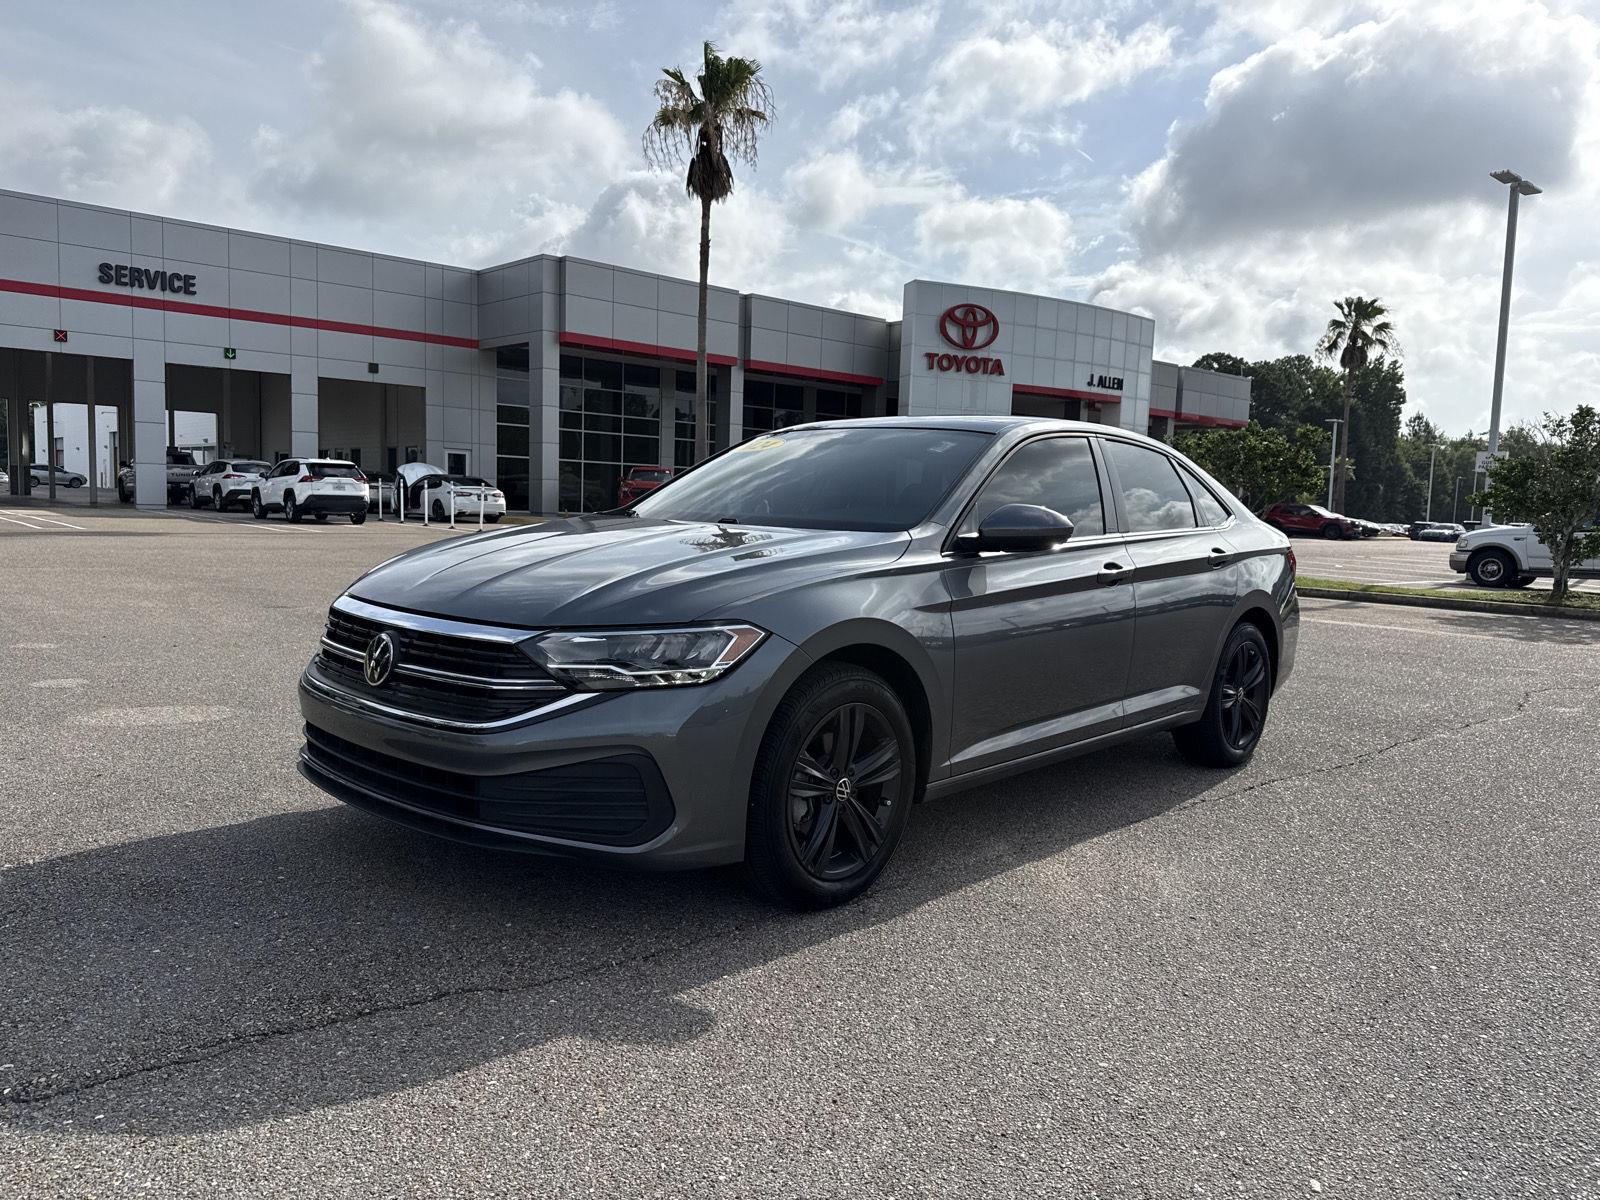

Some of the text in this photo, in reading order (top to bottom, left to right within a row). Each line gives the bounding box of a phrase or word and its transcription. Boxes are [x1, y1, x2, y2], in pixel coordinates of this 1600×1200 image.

[98, 262, 197, 295] SERVICE
[925, 352, 1005, 376] TOYOTA
[1087, 373, 1124, 391] J. ALLEN
